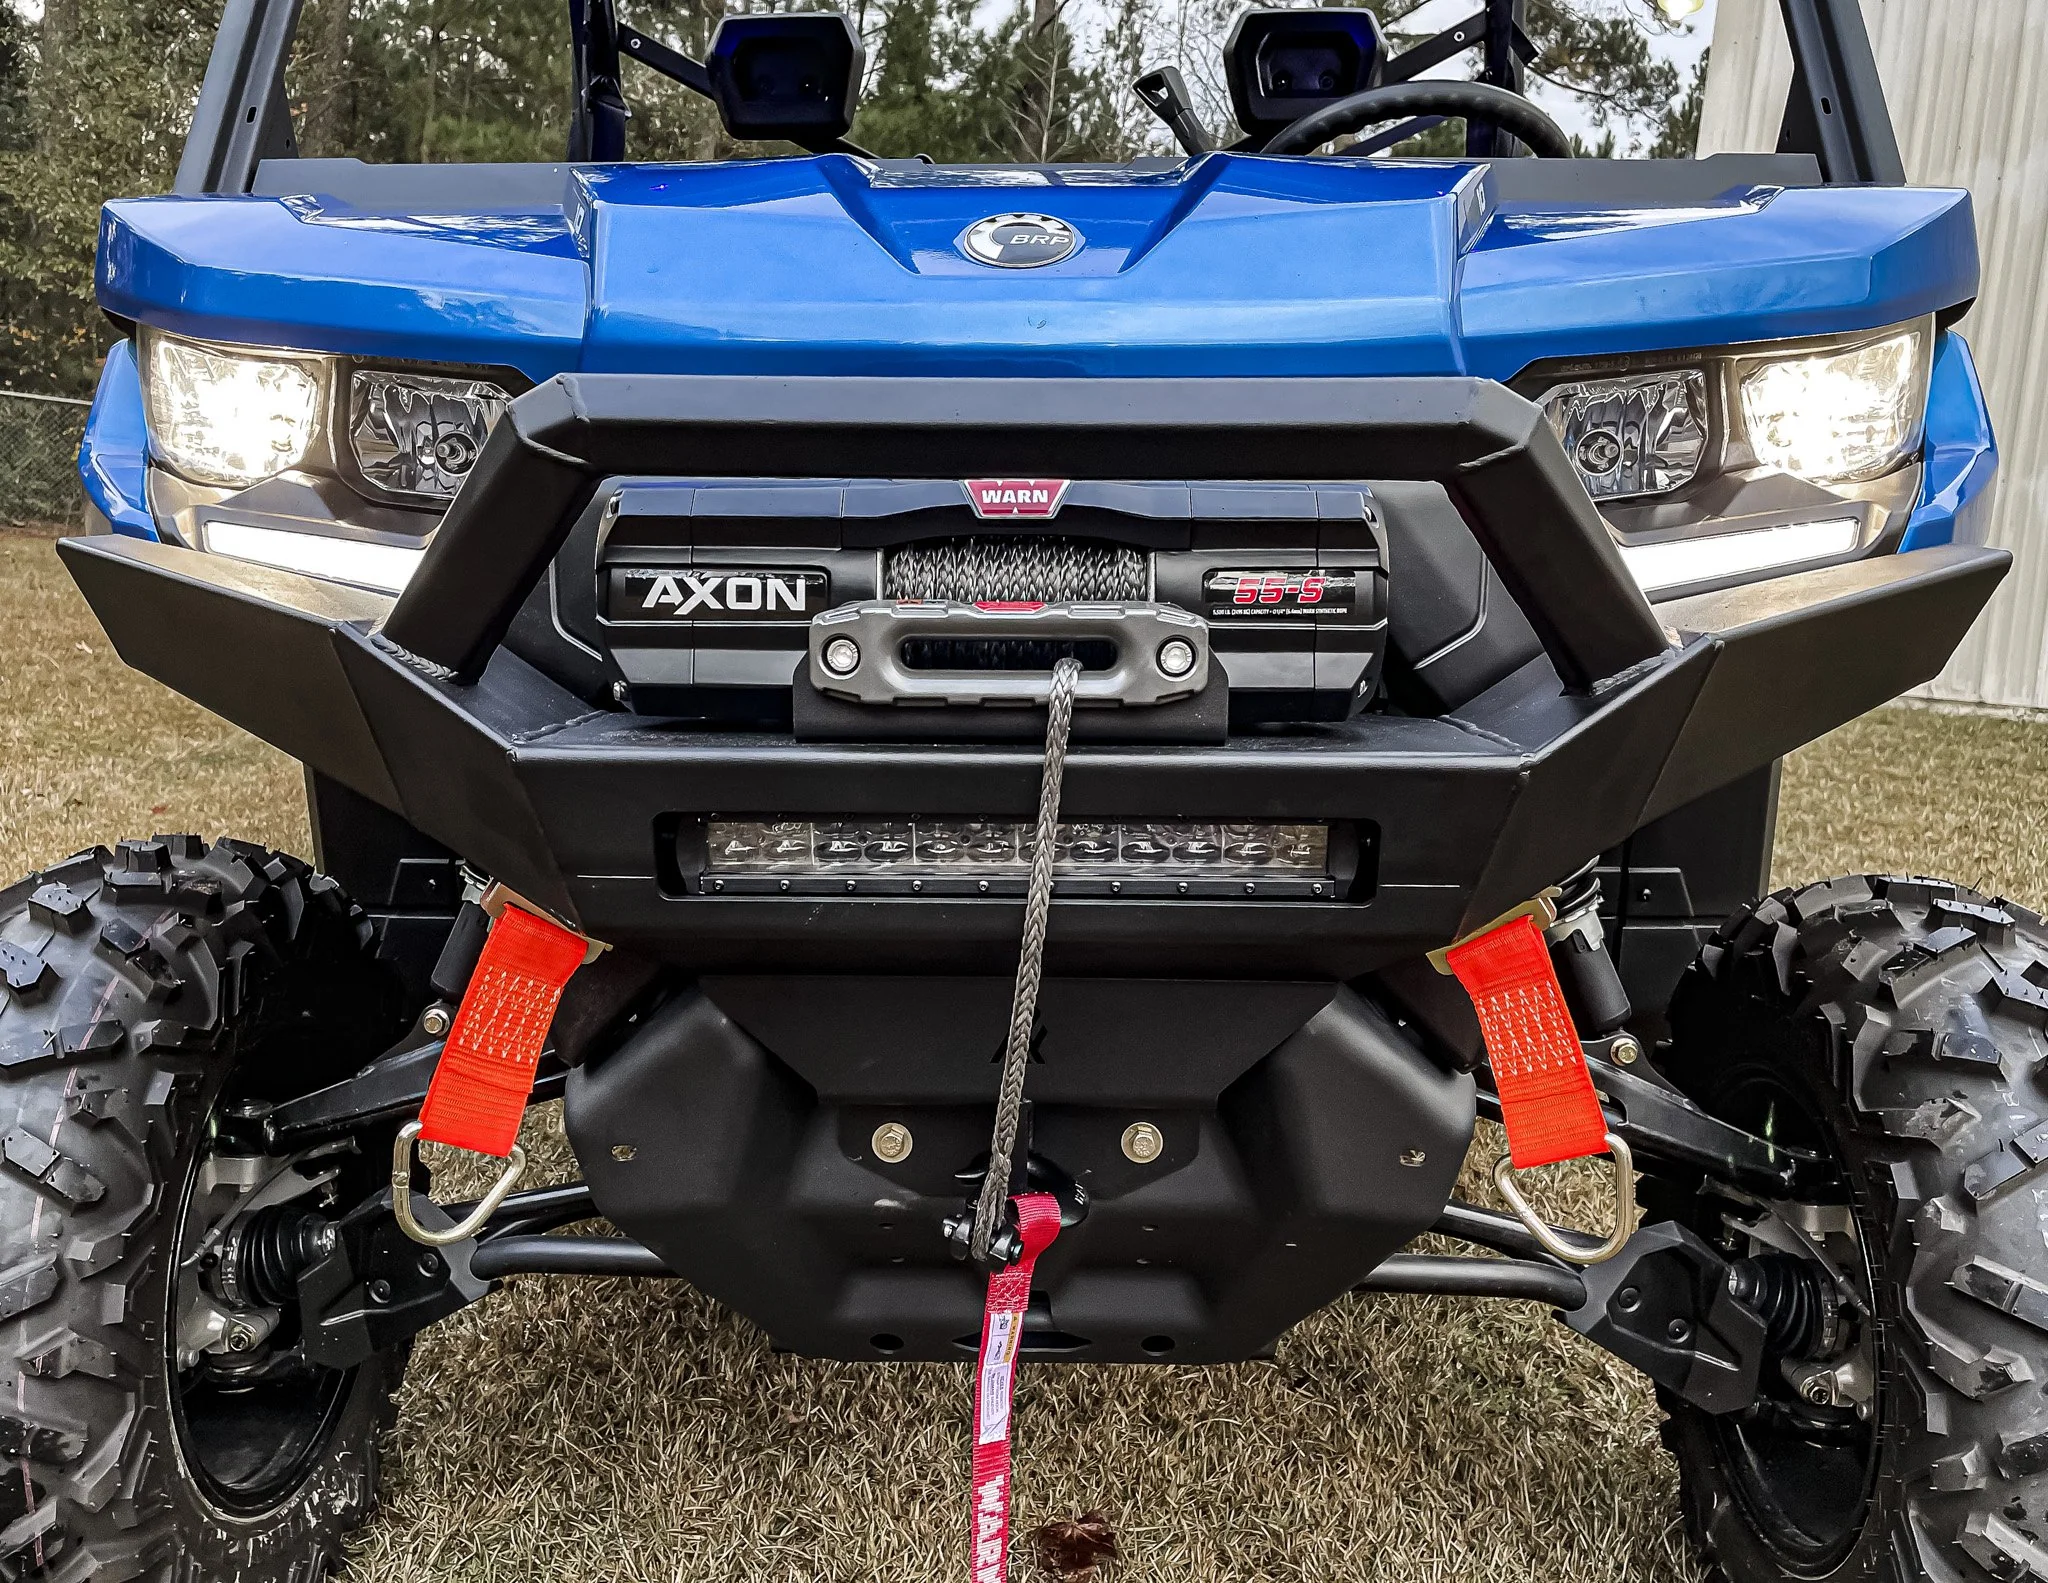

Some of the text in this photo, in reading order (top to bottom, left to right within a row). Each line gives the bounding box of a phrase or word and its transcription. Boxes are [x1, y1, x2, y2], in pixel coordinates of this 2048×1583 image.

[1010, 234, 1070, 246] BRP
[981, 489, 1048, 504] WARN
[641, 575, 806, 615] AXON
[1233, 577, 1327, 604] 55-S
[1005, 1326, 1016, 1357] WARNING
